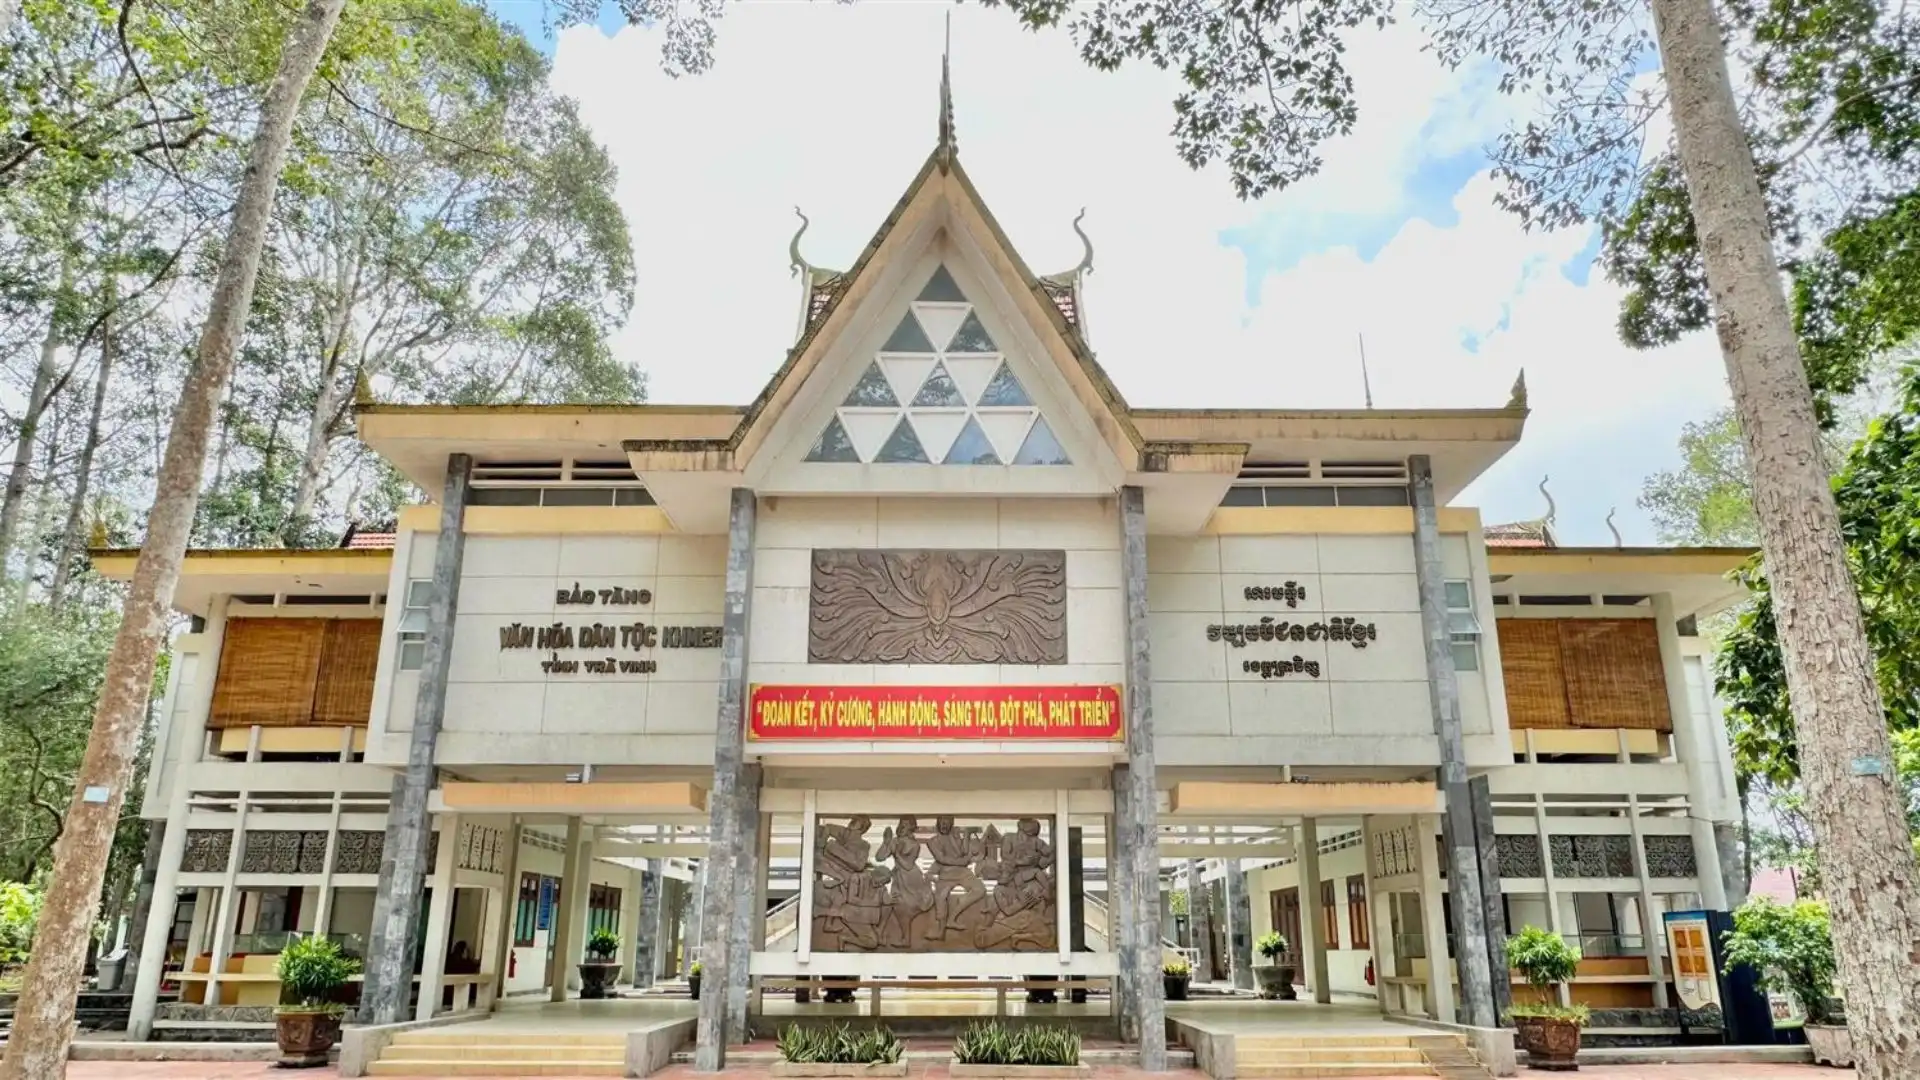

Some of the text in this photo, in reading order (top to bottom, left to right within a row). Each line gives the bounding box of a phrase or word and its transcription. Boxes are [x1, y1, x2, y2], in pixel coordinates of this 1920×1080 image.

[556, 582, 595, 605] BẢO
[500, 622, 723, 651] VĂN HÓA DÂN TỘC KHMER
[541, 652, 579, 674] TỈNH
[620, 660, 657, 673] VINH
[794, 690, 817, 732] KẾT,
[878, 694, 907, 727] HÀNH
[910, 694, 941, 735] ĐỘNG,
[943, 694, 972, 727] SÁNG
[974, 700, 998, 734] TẠO,
[1000, 694, 1021, 736] ĐỘT
[1023, 693, 1048, 732] PHÁ,
[1049, 693, 1077, 727] PHÁT
